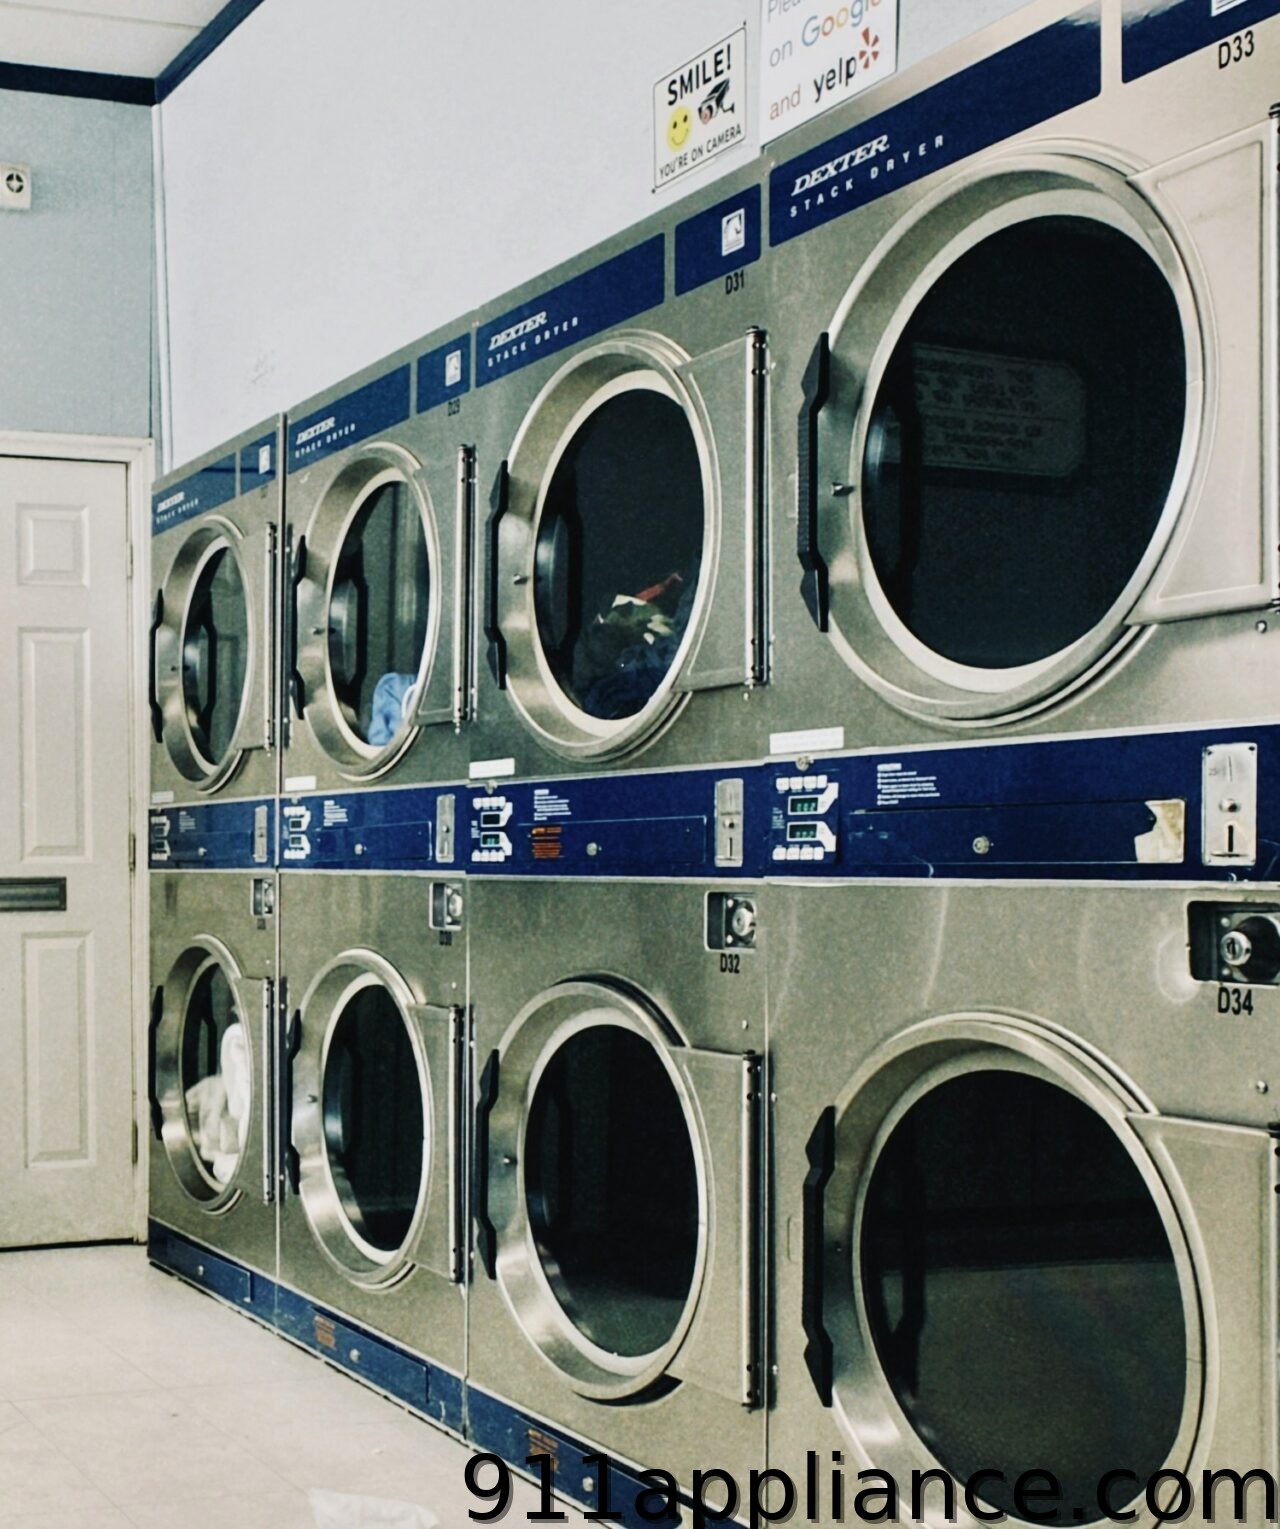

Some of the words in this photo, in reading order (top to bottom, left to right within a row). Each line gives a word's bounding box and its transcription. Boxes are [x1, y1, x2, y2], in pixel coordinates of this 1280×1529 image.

[769, 40, 793, 67] on
[1218, 30, 1255, 70] D33
[667, 42, 731, 106] SMILE!
[769, 82, 801, 120] and
[813, 56, 857, 103] yelp
[658, 151, 689, 179] YOU'RE
[691, 144, 704, 162] ON
[706, 123, 742, 154] CAMERA
[790, 134, 890, 197] DEXTER
[790, 178, 853, 218] STACK
[870, 134, 944, 180] DRYER
[725, 269, 745, 295] D31
[488, 311, 548, 351] DEXTER
[720, 953, 741, 974] D32
[1217, 986, 1254, 1016] D34
